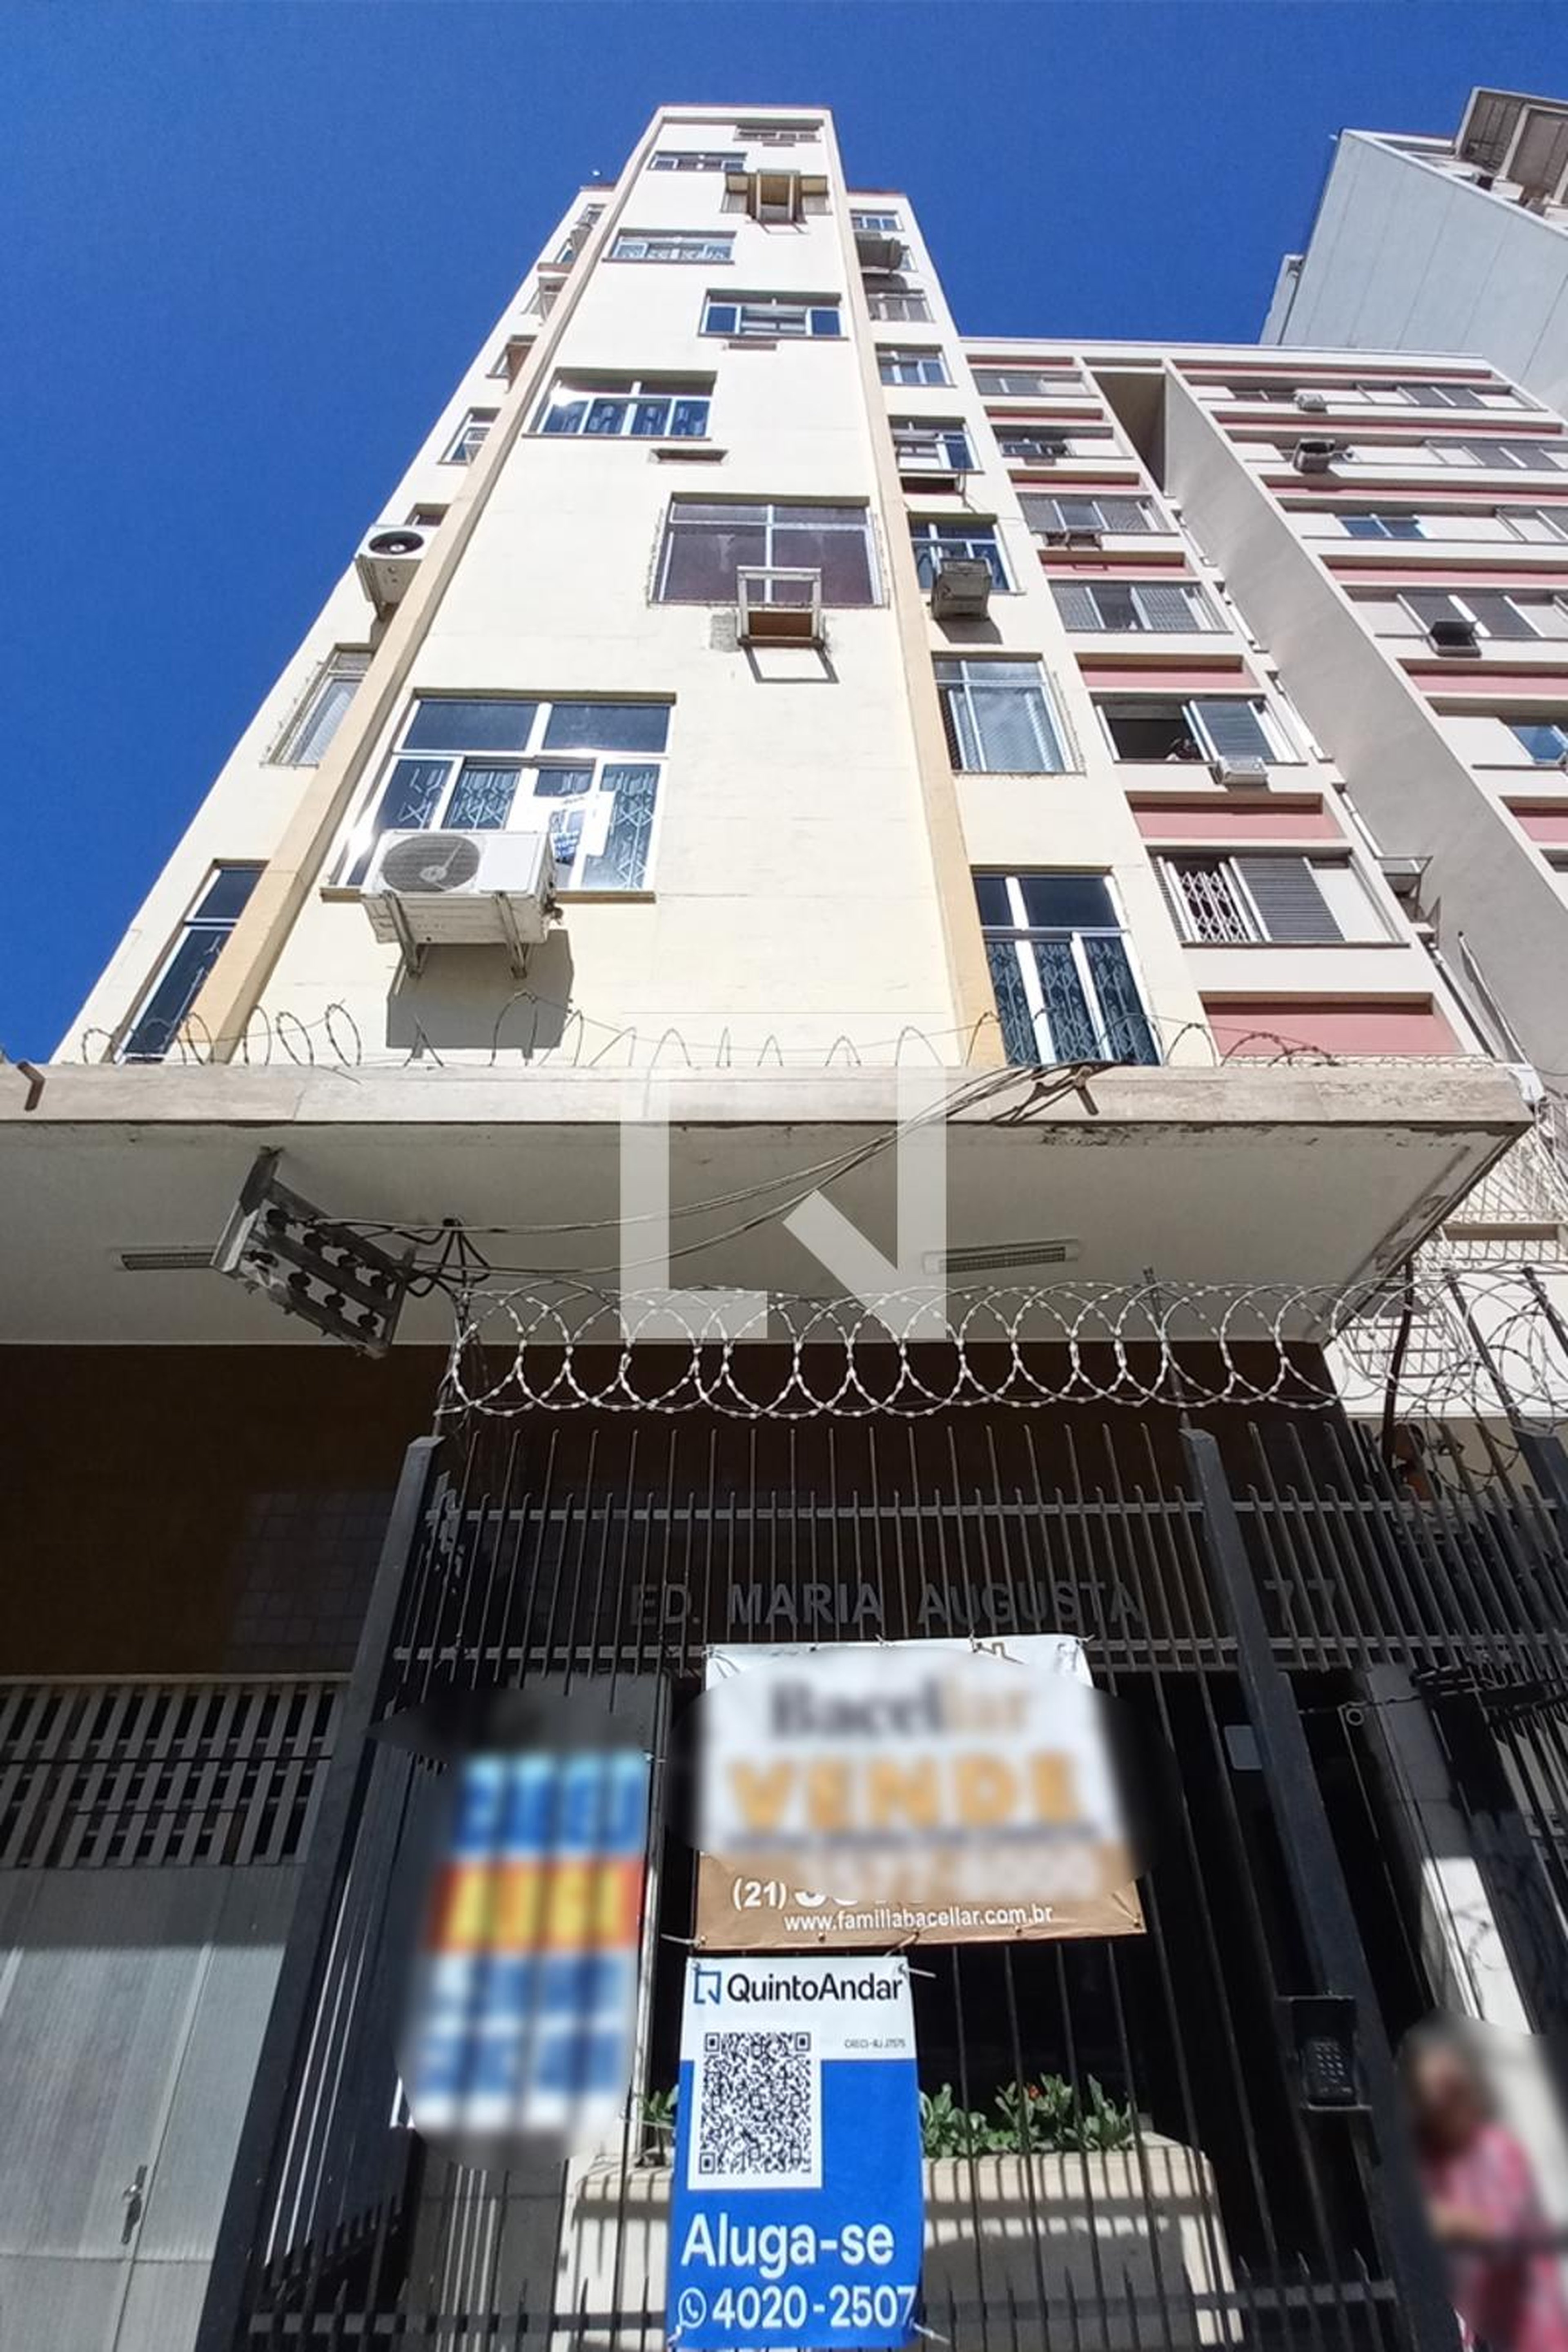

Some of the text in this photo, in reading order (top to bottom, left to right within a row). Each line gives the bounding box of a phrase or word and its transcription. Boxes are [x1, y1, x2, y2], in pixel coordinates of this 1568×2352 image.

[630, 1581, 1145, 1625] ED. MARIA AUGUSTA
[733, 1878, 786, 1910] (21)
[784, 1905, 1054, 1931] www.familiabacellar.com.br
[727, 1972, 904, 2003] QuintoAndar
[680, 2212, 895, 2279] Aluga-se
